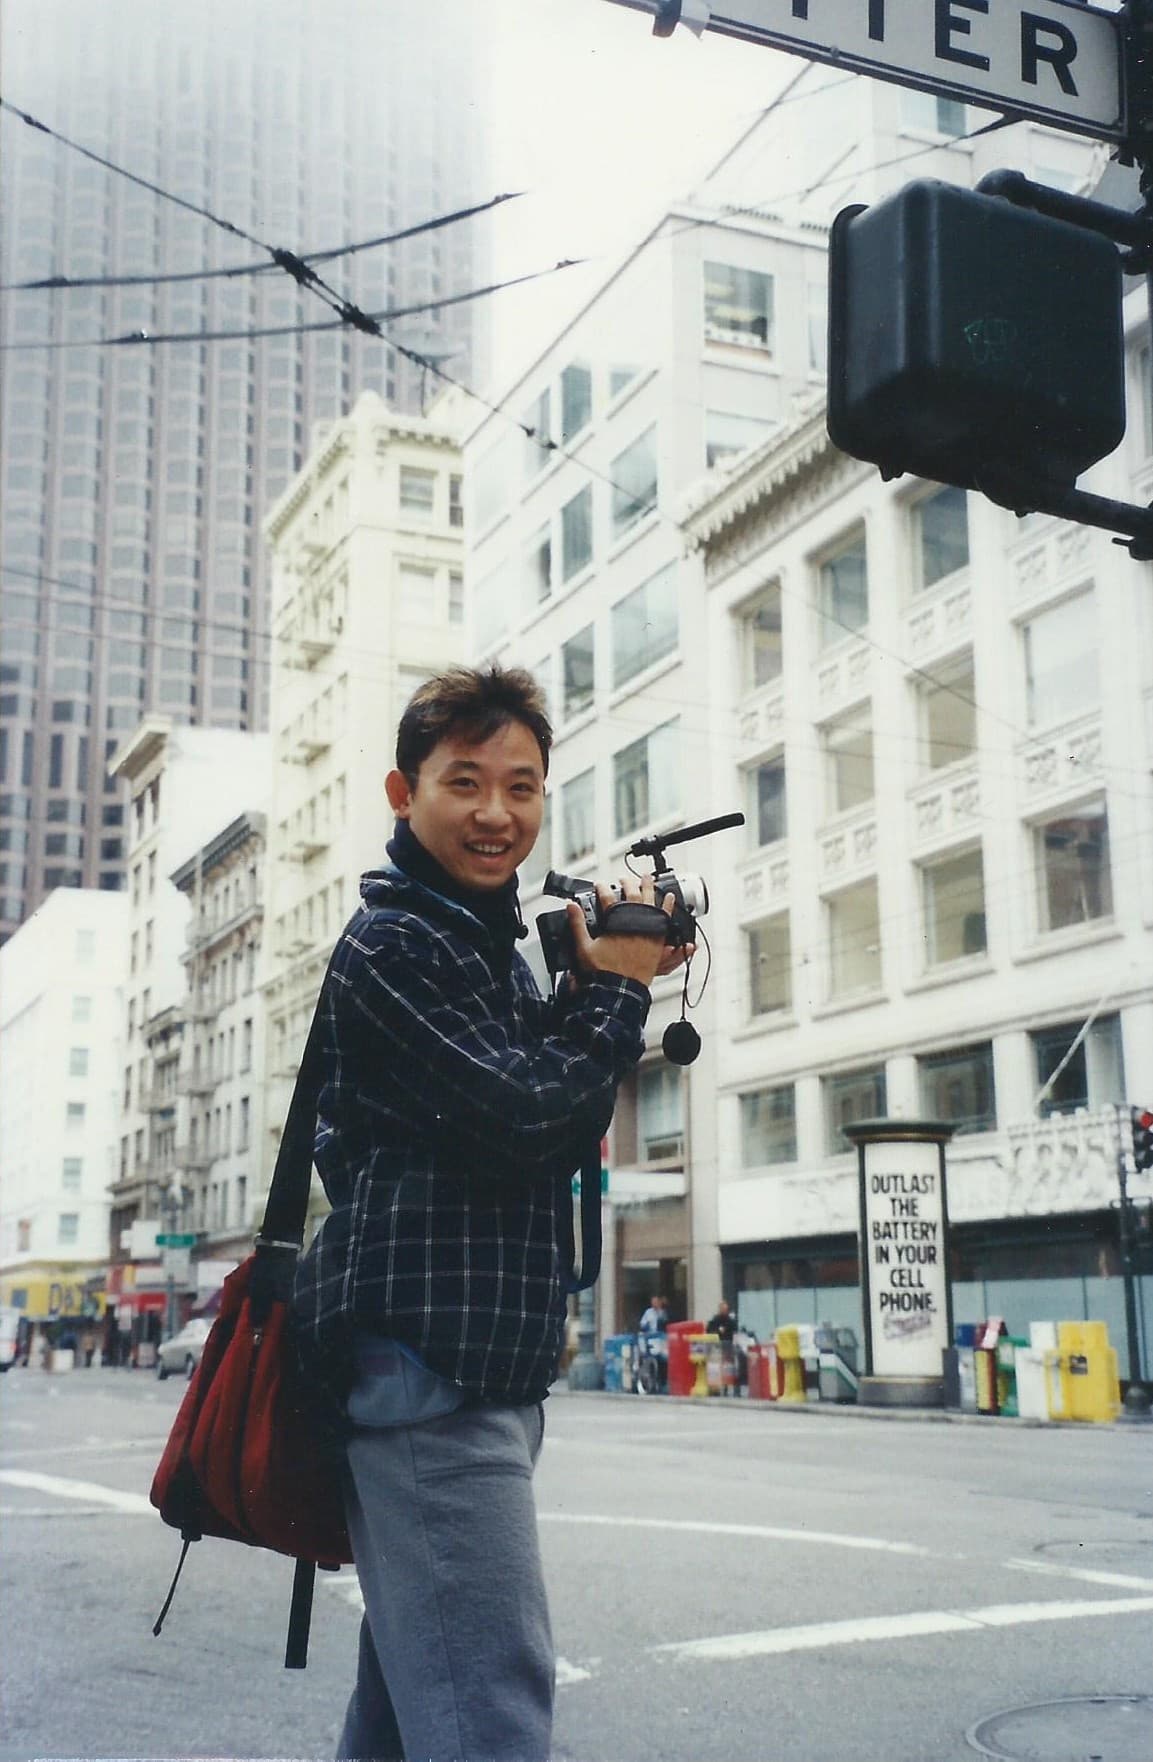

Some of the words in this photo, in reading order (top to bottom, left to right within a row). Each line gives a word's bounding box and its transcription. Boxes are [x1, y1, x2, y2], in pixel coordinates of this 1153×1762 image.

[871, 1174, 935, 1194] OUTLAST
[890, 1198, 919, 1217] THE
[873, 1221, 937, 1241] BATTERY
[875, 1245, 889, 1264] IN
[895, 1245, 937, 1264] YOUR
[890, 1269, 924, 1288] CELL
